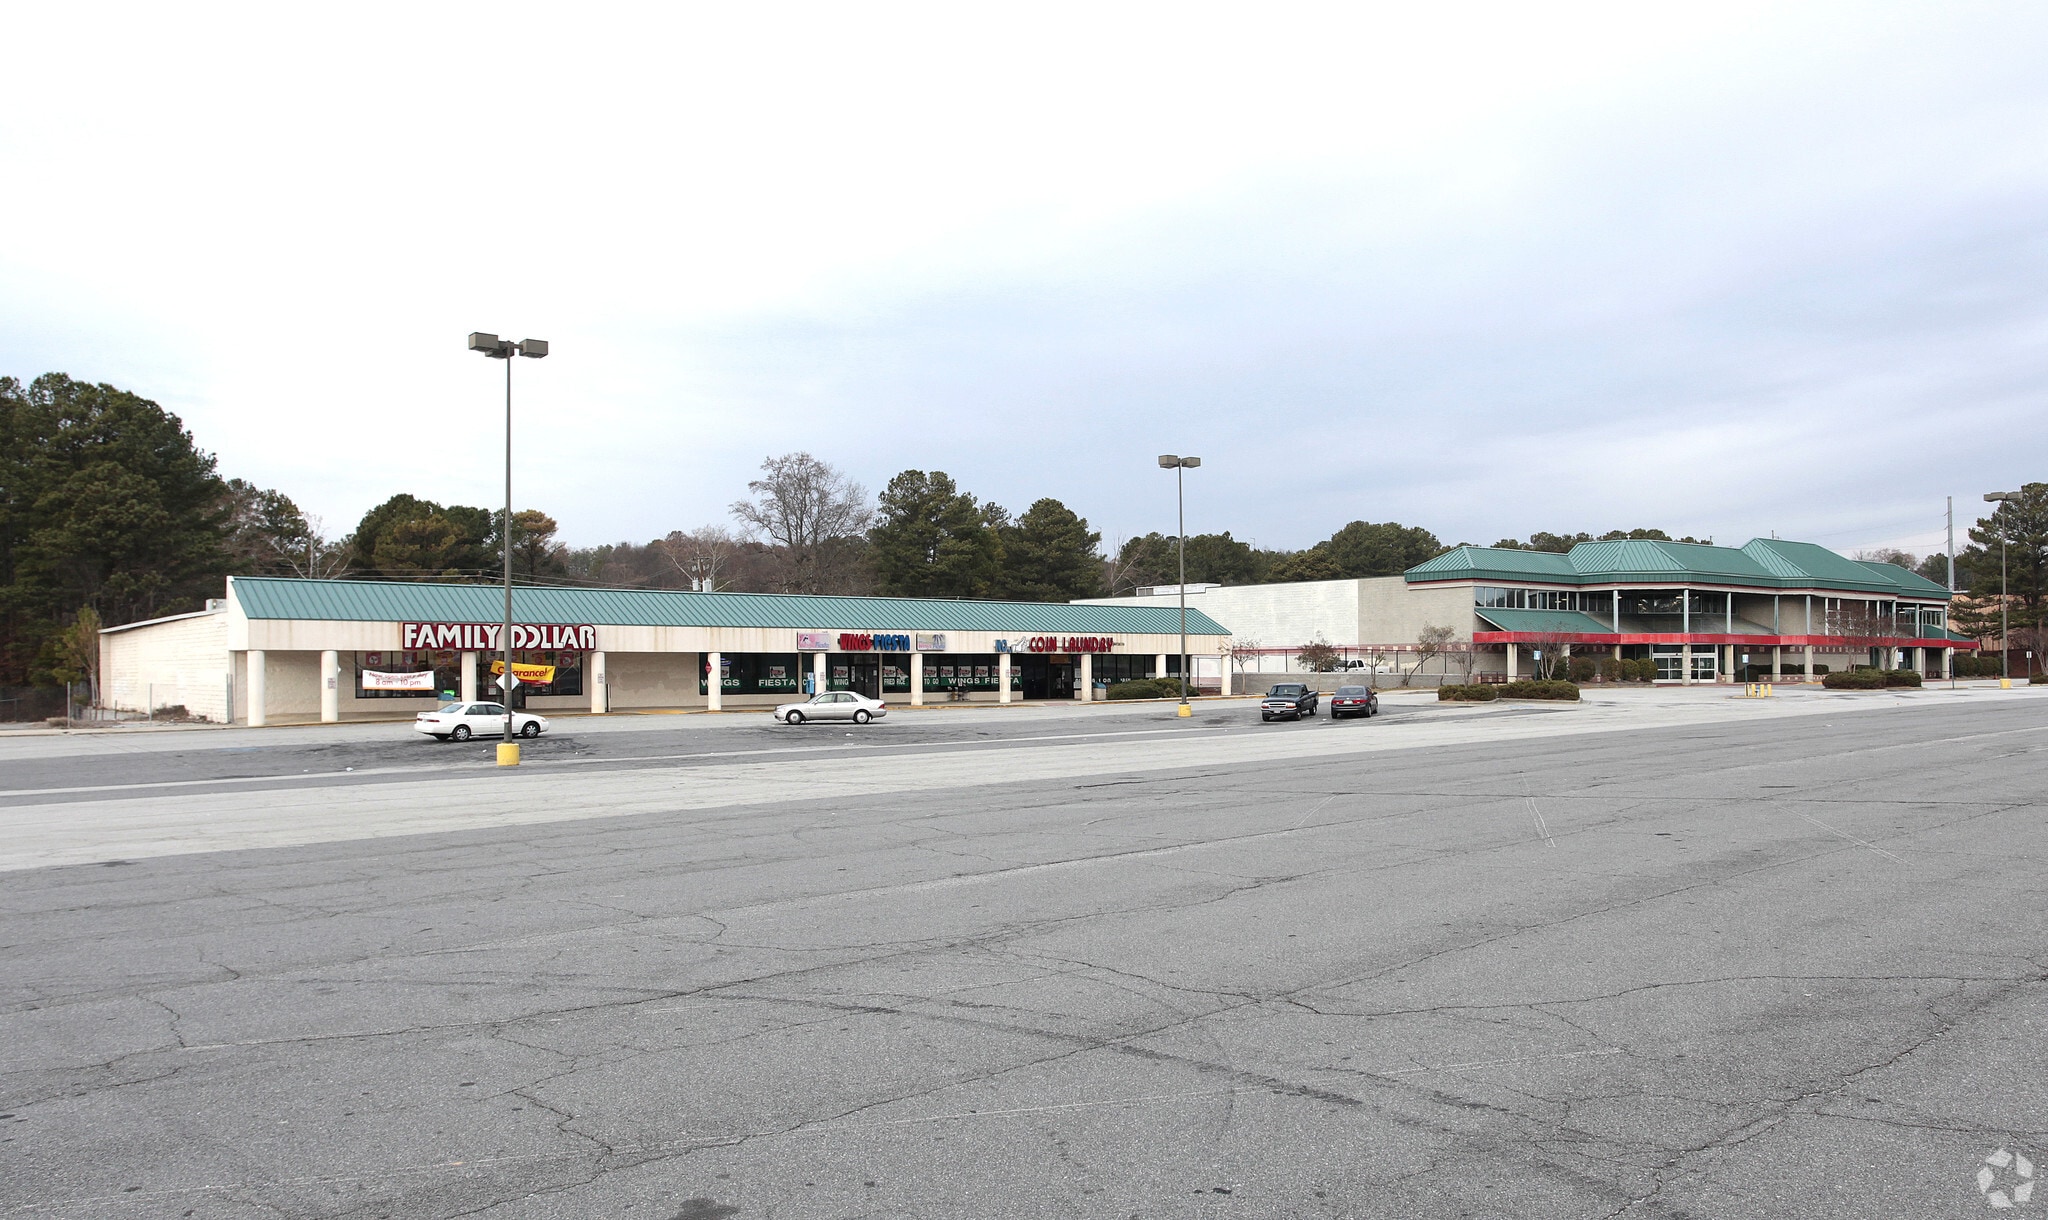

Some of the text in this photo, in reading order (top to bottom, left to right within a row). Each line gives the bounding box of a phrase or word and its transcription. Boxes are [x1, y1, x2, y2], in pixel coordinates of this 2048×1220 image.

[403, 624, 595, 649] FAMILY DOLLAR
[839, 633, 910, 651] WINGS FIESTA
[1029, 637, 1057, 652] COIN
[1062, 637, 1113, 652] LAUNDRY
[497, 666, 548, 677] Carance!
